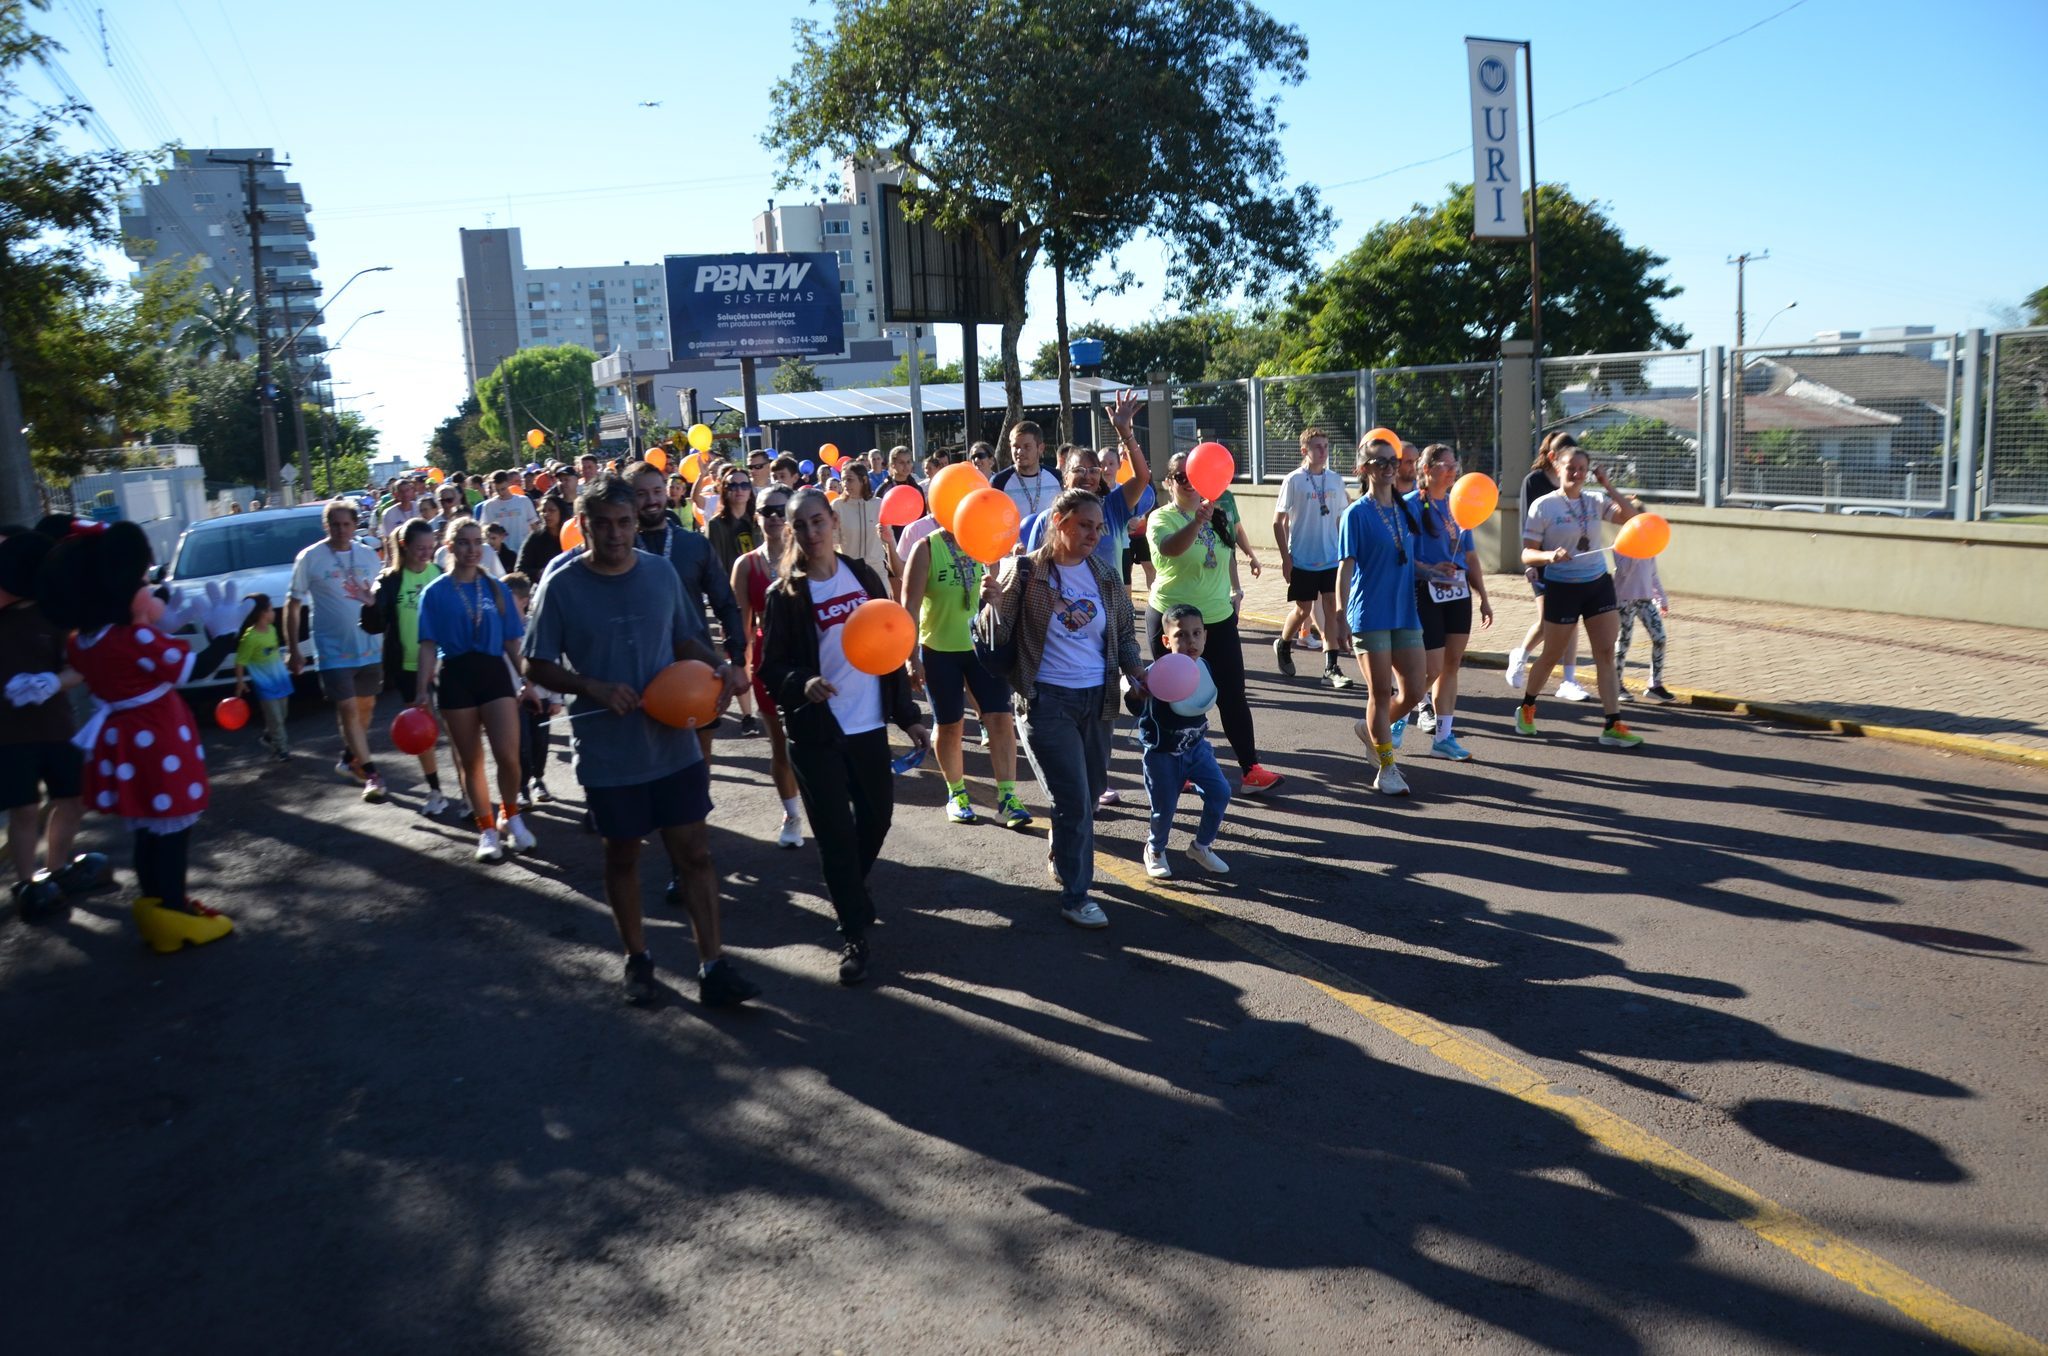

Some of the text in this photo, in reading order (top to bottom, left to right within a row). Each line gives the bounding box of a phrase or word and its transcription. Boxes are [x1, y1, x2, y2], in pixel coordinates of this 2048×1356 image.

[1481, 106, 1511, 222] URI
[694, 262, 812, 293] PBNEW
[724, 292, 814, 304] SISTEMAS
[717, 311, 796, 321] Soluções tecnológicas
[730, 320, 761, 328] produtos
